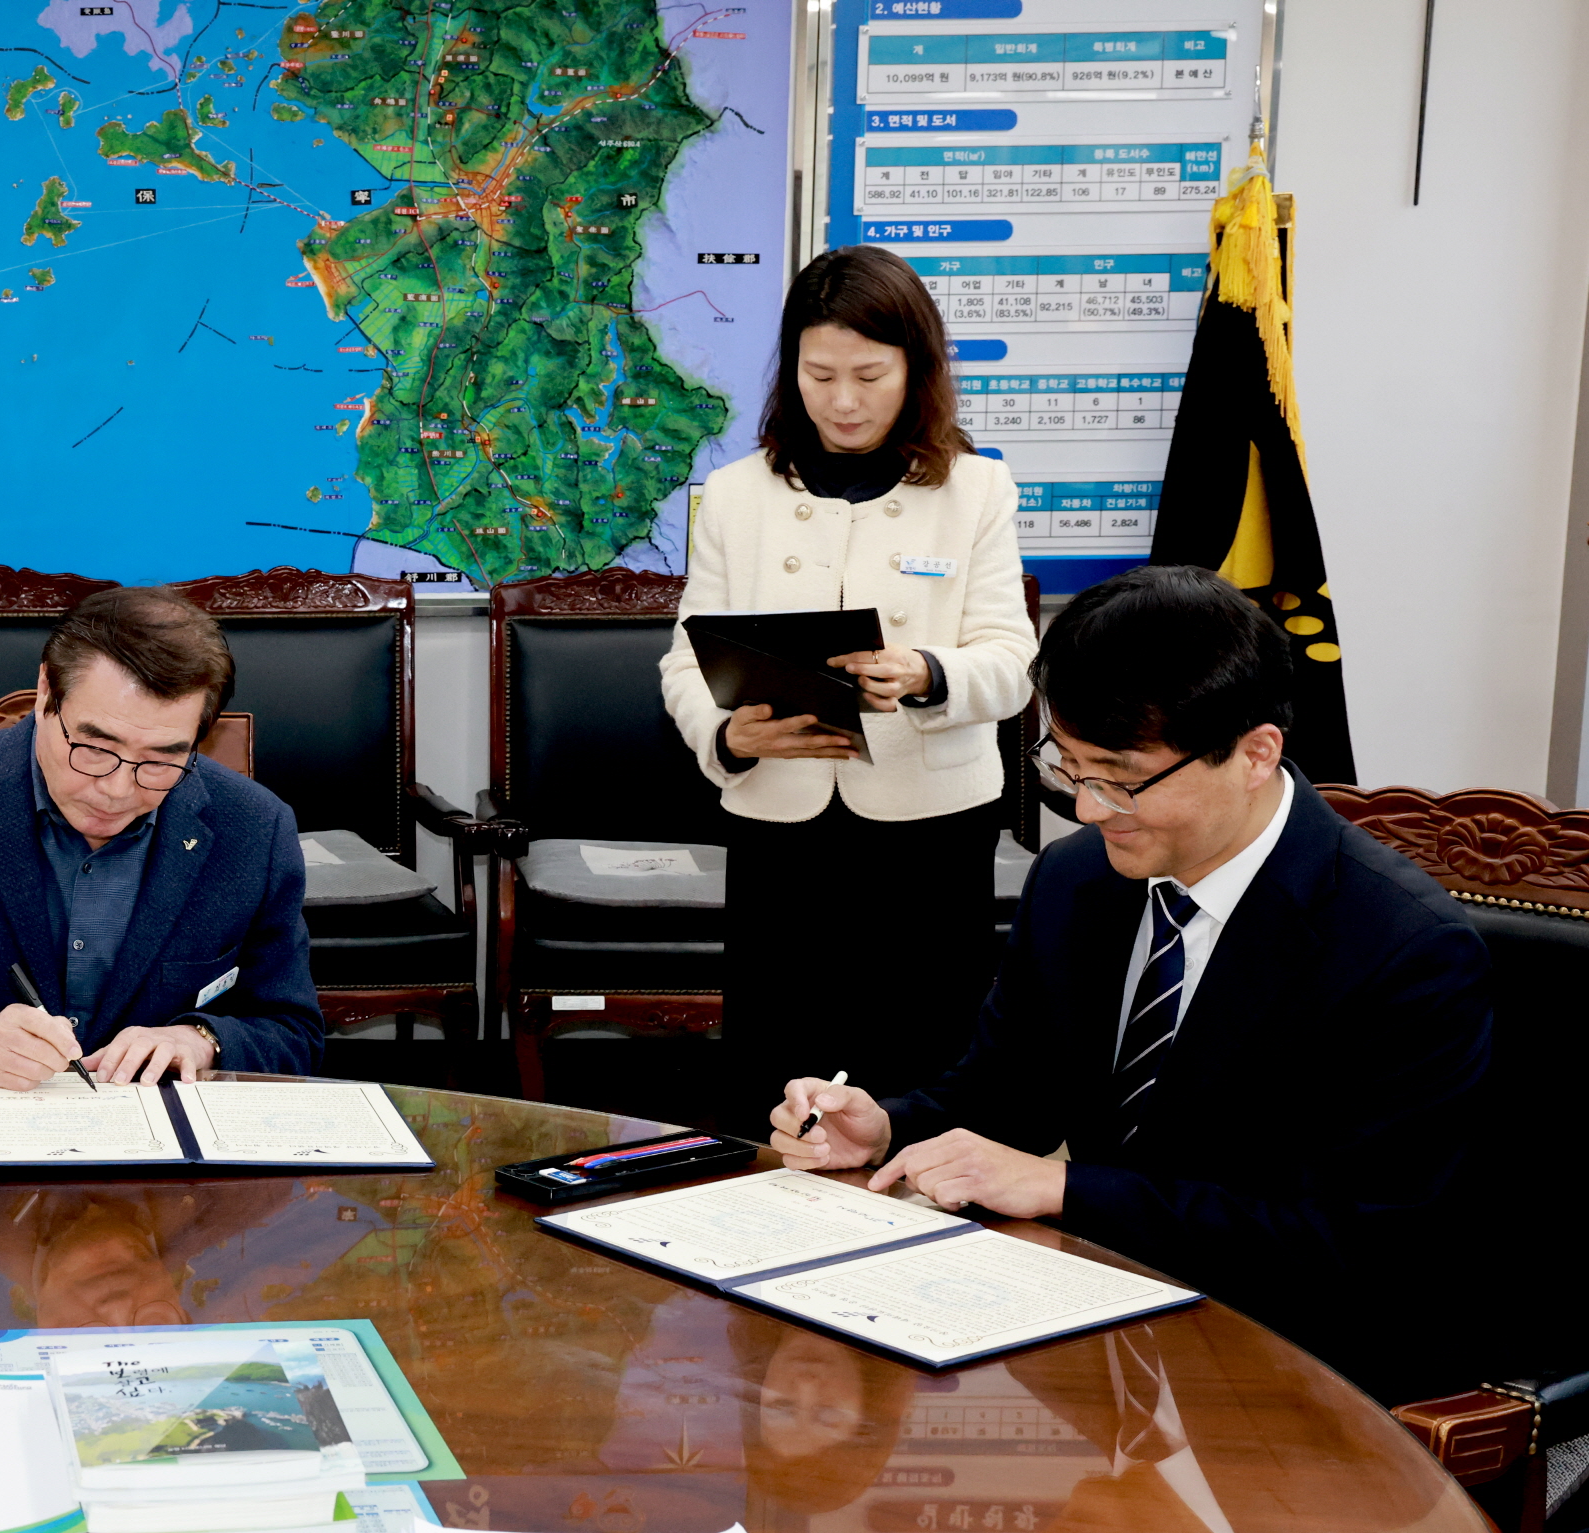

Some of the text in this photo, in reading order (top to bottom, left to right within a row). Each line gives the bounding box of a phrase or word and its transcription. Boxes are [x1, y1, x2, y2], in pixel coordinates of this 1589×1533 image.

[872, 114, 956, 127] 3. 면적 및 도서
[136, 190, 155, 203] 保
[867, 224, 952, 238] 4. 가구 및 인구
